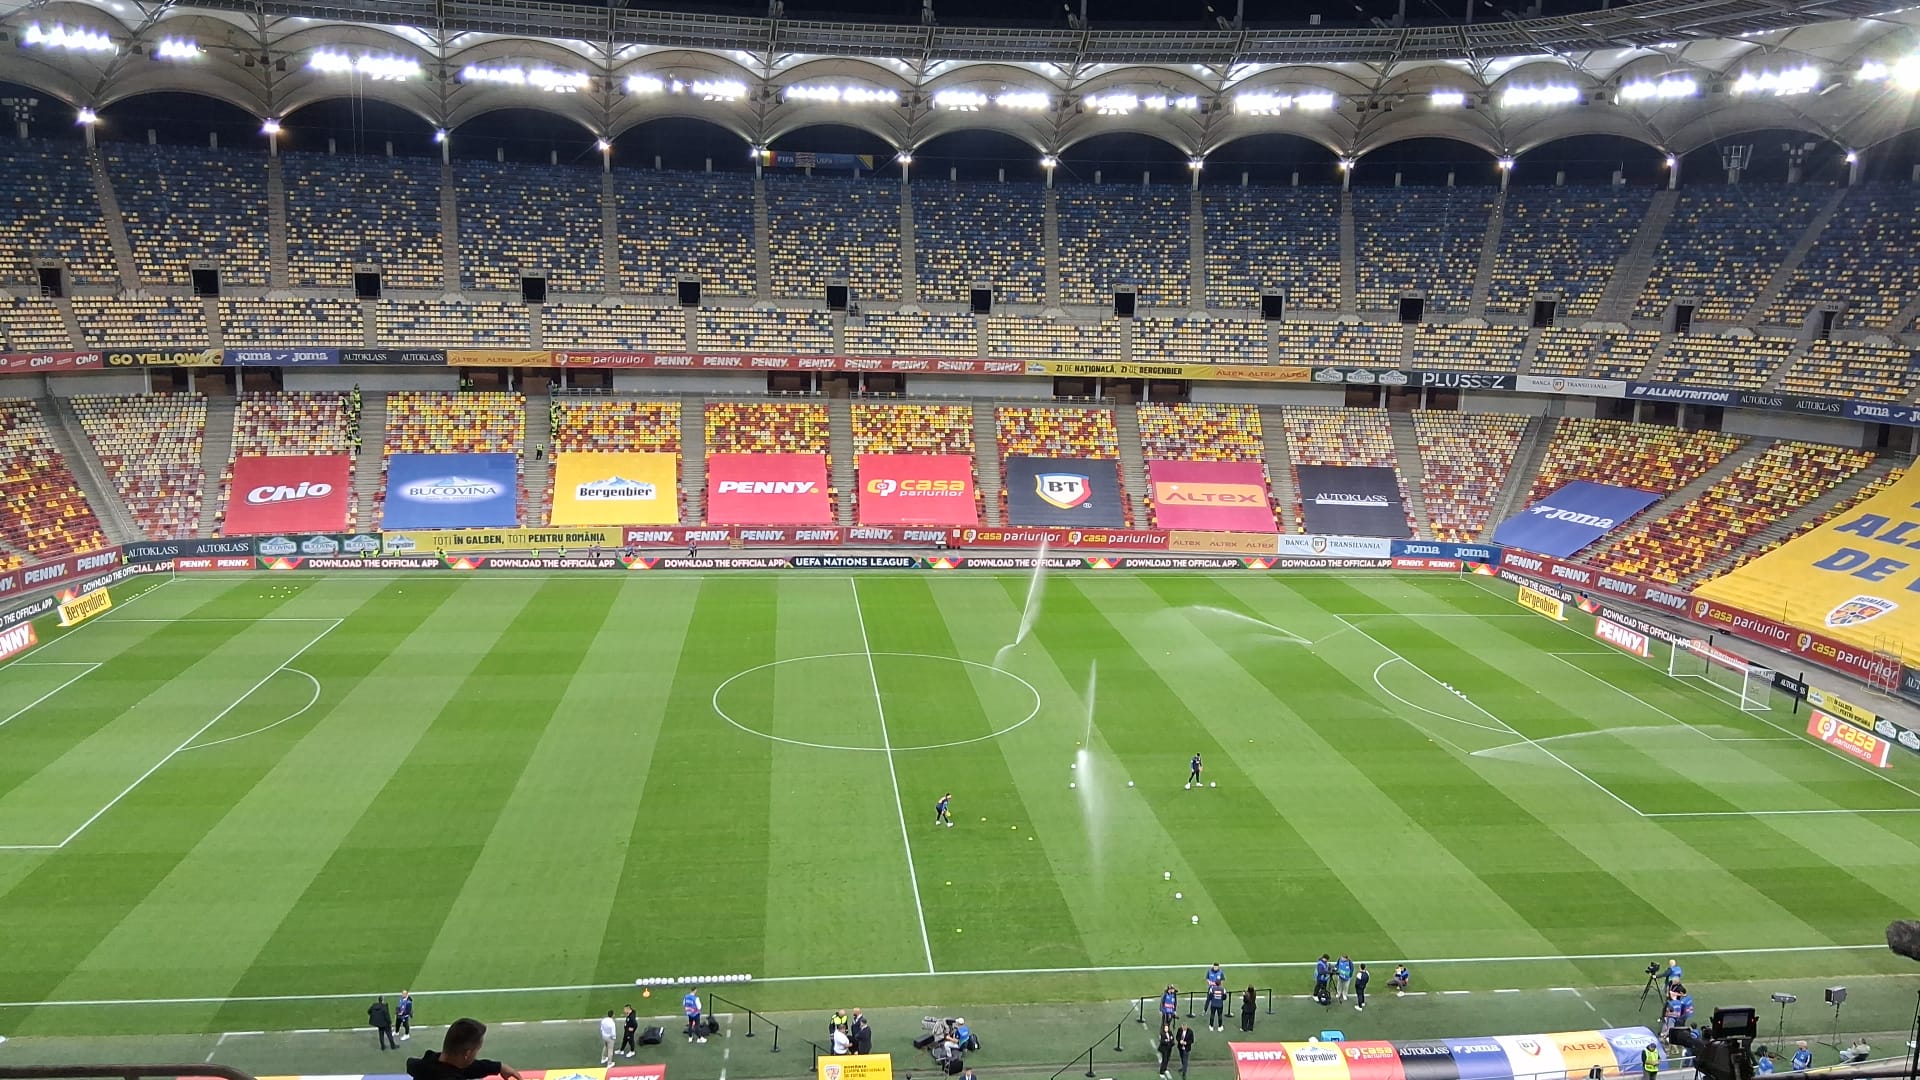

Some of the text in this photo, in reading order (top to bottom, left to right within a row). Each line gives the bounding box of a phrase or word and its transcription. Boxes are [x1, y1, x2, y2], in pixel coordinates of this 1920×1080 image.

[30, 353, 54, 367] Chio
[75, 353, 99, 365] Chio
[109, 353, 204, 366] GO YELLOW
[343, 353, 388, 362] AUTOKLASS
[401, 353, 444, 362] AUTOKLASS
[569, 354, 645, 367] casa pariurilor
[1139, 366, 1183, 375] BERGENBIER
[1646, 387, 1729, 402] ALLNUTRITION
[1740, 395, 1782, 406] AUTOKLASS
[1795, 400, 1840, 412] AUTOKLASS
[900, 479, 966, 491] casa
[1048, 481, 1079, 494] BT
[247, 481, 332, 503] Chio
[409, 487, 497, 496] BUCOVINA
[579, 486, 653, 499] Bergenbier
[899, 489, 964, 497] pariurilor
[1315, 493, 1389, 503] AUTOKLASS
[528, 533, 564, 543] PENTRU
[566, 532, 606, 542] ROMÂNIA
[978, 531, 1061, 543] casa pariurilor
[1083, 533, 1166, 545] casa pariurilor
[128, 545, 178, 557] AUTOKLASS
[196, 542, 249, 554] AUTOKLASS
[1329, 541, 1381, 550] TRANSILVANIA
[309, 559, 438, 568] DOWNLOAD THE OFFICIAL APP
[490, 559, 615, 568] DOWNLOAD THE OFFICIAL APP
[664, 559, 784, 568] DOWNLOAD THE OFFICIAL APP
[796, 558, 909, 567] UEFA NATIONS LEAGUE
[967, 559, 1081, 567] DOWNLOAD THE OFFICIAL APP
[1126, 559, 1237, 567] DOWNLOAD THE OFFICIAL APP
[1281, 559, 1392, 567] DOWNLOAD THE OFFICIAL APP
[1812, 547, 1909, 582] DE
[82, 562, 173, 593] DOWNLOAD THE OFFICIAL APP
[1501, 571, 1572, 602] DOWNLOAD THE OFFICIAL APP
[65, 591, 107, 621] Bergenbier
[1521, 588, 1557, 615] Bergenbier
[3, 611, 15, 625] THE
[15, 602, 42, 620] OFFICIAL
[41, 598, 54, 612] APP
[1602, 607, 1637, 630] DOWNLOAD
[1638, 622, 1650, 635] THE
[1650, 626, 1676, 643] OFFICIAL
[1708, 606, 1791, 641] casa pariurilor
[1811, 641, 1898, 680] casa pariurilor
[1836, 721, 1877, 752] casa
[1833, 737, 1872, 760] pariurilor.ro
[1360, 1046, 1393, 1055] casa
[1399, 1046, 1451, 1056] AUTOKLASS
[1295, 1052, 1339, 1063] Bergenbier
